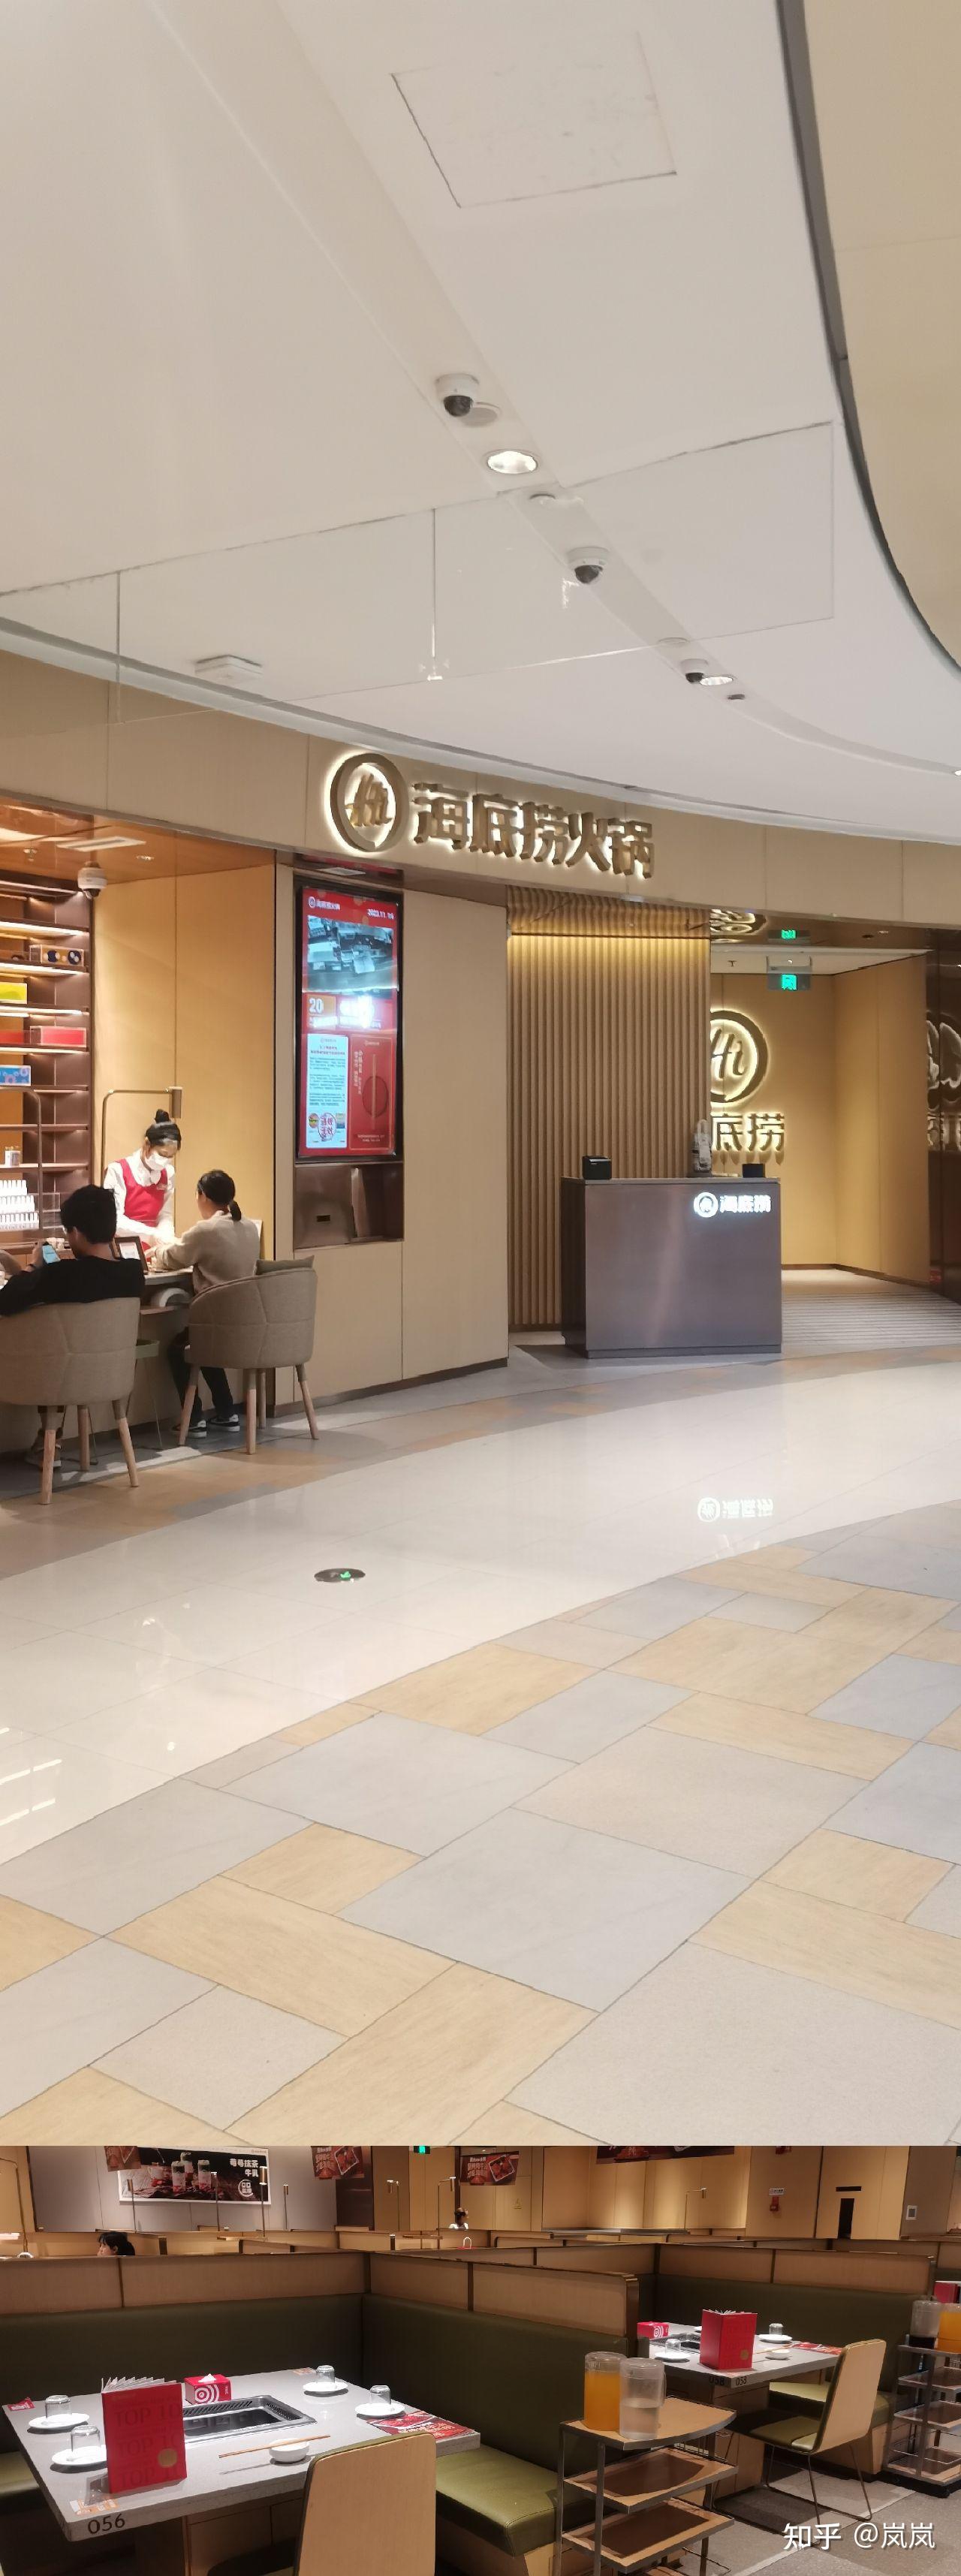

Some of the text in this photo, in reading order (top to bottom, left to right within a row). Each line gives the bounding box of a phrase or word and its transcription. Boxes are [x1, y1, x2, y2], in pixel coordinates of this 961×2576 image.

[412, 782, 656, 878] 海底捞火锅
[309, 998, 324, 1014] 20
[712, 1114, 785, 1152] 底捞
[88, 2513, 125, 2534] 056
